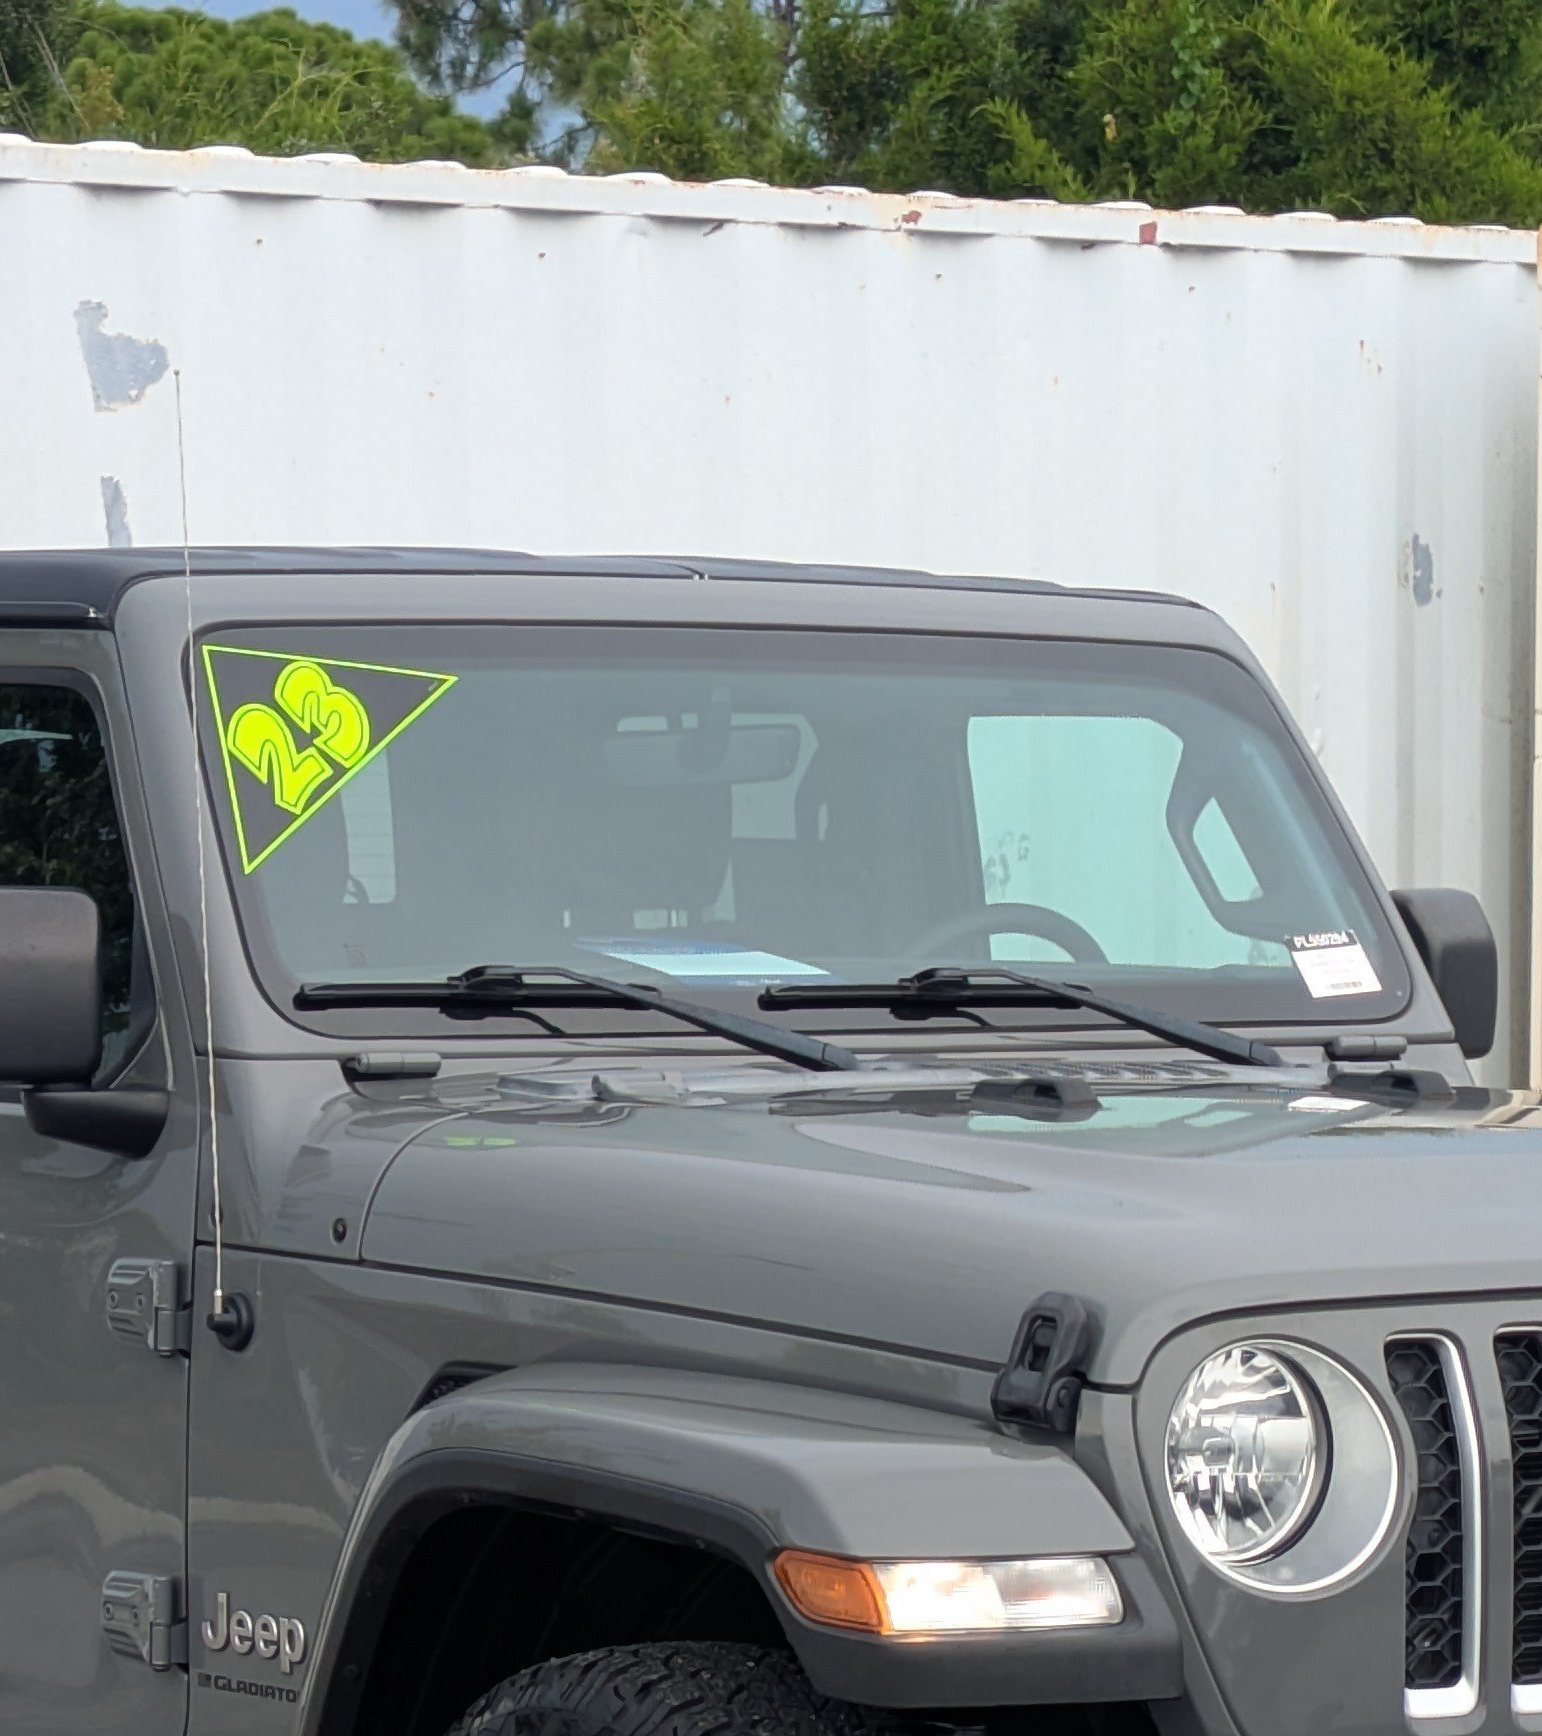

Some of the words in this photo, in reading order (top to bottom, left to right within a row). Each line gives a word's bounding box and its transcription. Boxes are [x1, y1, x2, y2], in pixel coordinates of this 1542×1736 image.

[227, 660, 371, 815] 23
[201, 1592, 305, 1674] Jeep
[213, 1674, 300, 1703] GLADIATO
